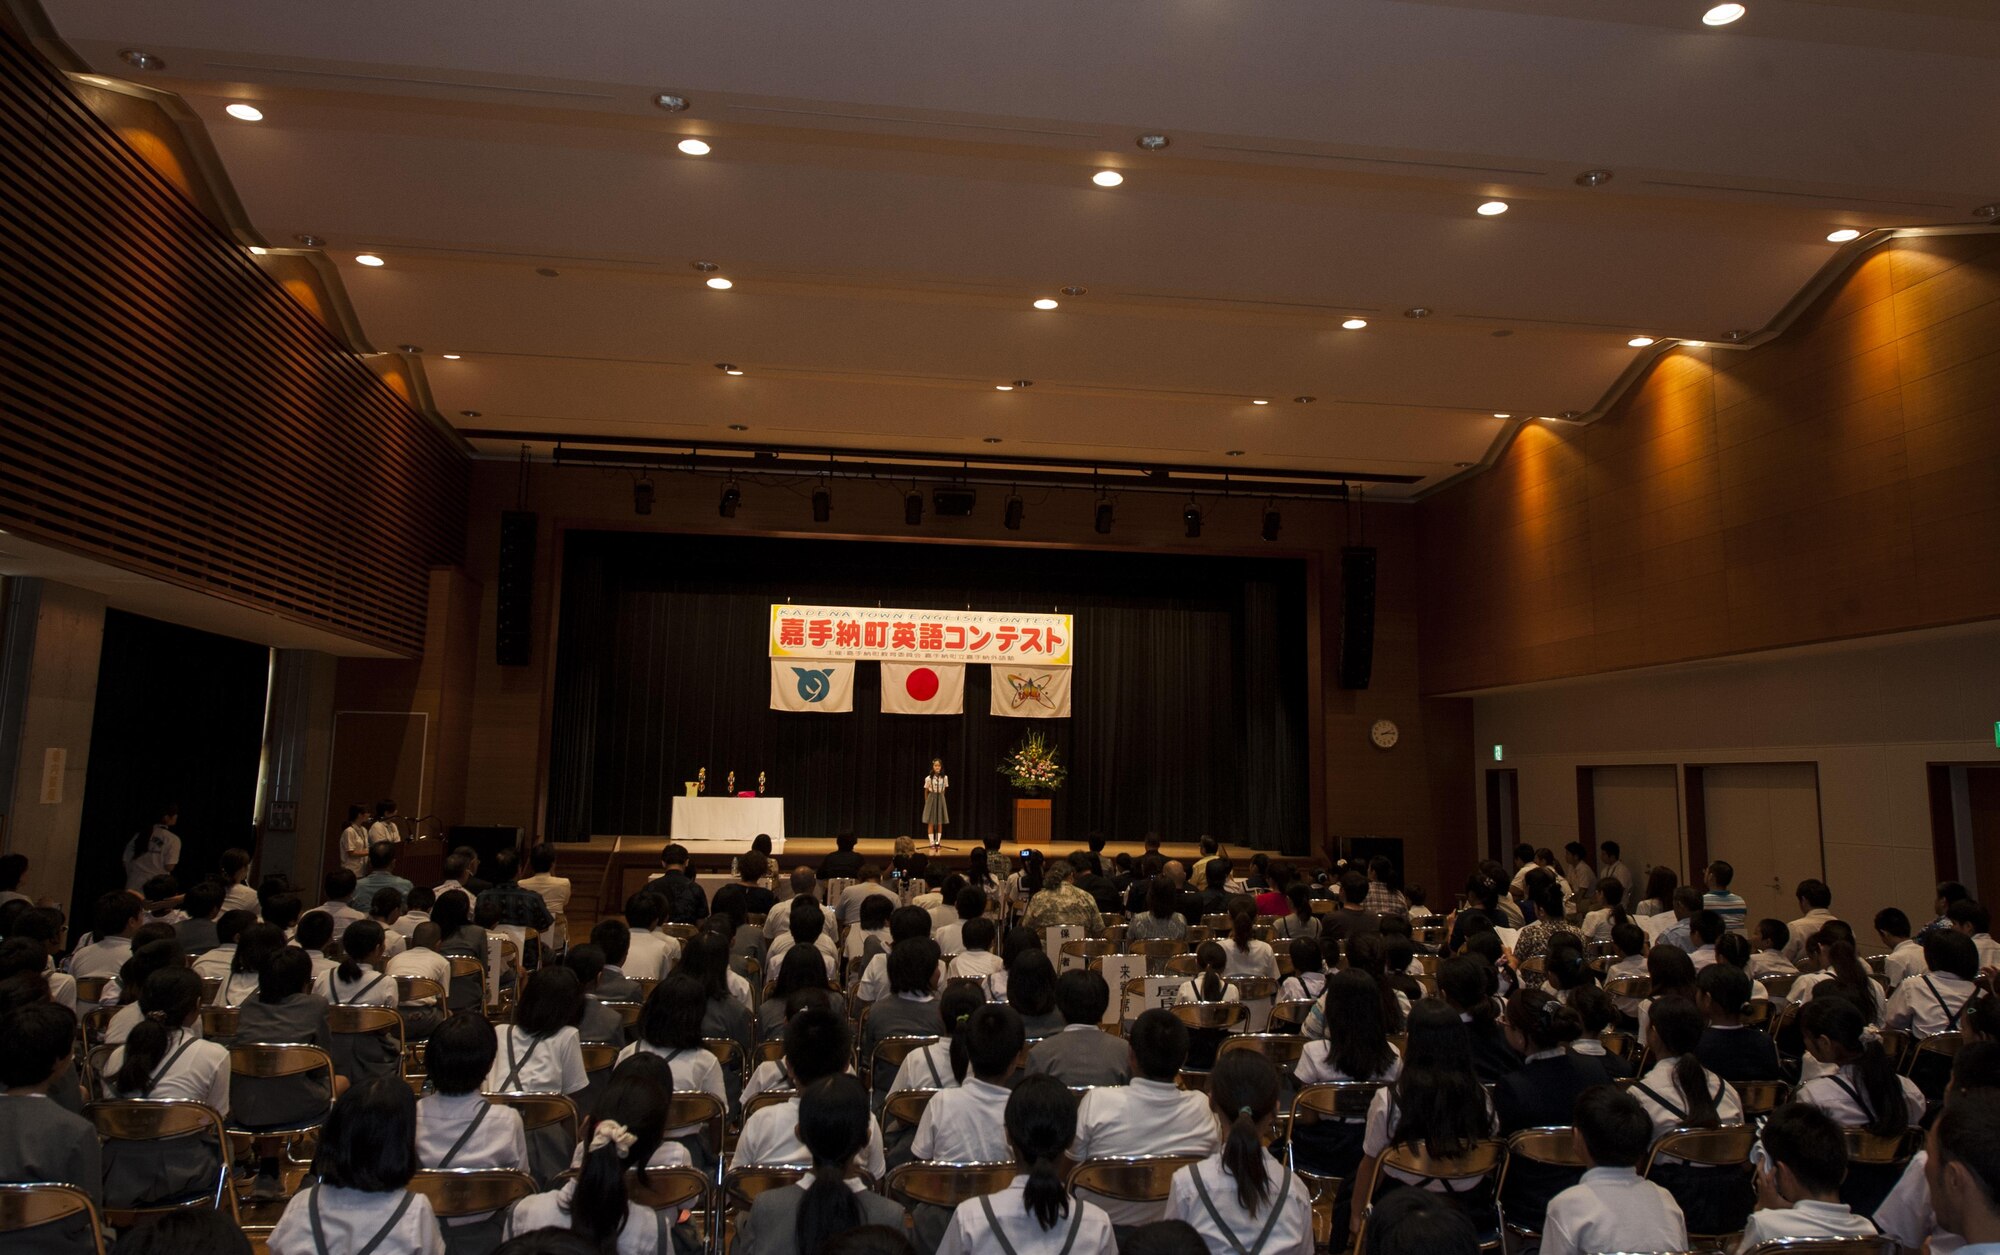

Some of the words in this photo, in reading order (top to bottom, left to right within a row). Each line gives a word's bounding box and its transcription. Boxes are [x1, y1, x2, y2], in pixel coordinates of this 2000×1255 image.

[779, 609, 850, 618] KADENA
[909, 613, 983, 622] ENGLISH
[988, 616, 1063, 625] CONTEST
[779, 618, 1063, 654] 嘉手納町英語コンテスト
[1060, 929, 1070, 967] 保者
